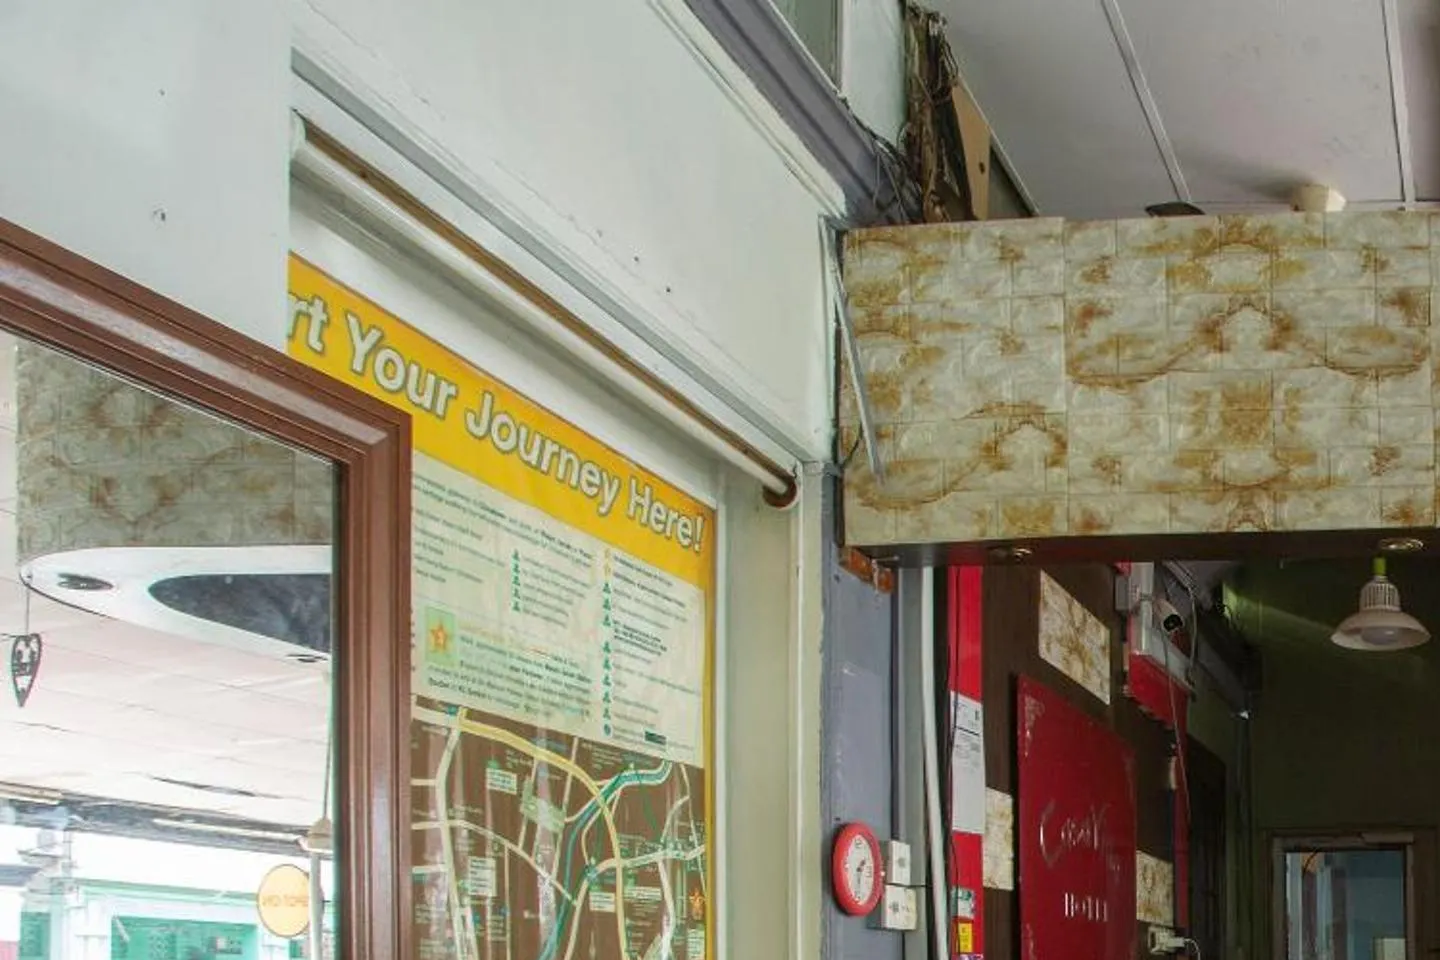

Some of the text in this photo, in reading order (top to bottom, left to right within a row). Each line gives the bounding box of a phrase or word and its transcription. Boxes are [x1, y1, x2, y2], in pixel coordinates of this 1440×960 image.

[344, 309, 459, 421] Your
[464, 391, 622, 516] Journey
[626, 475, 705, 552] Here!
